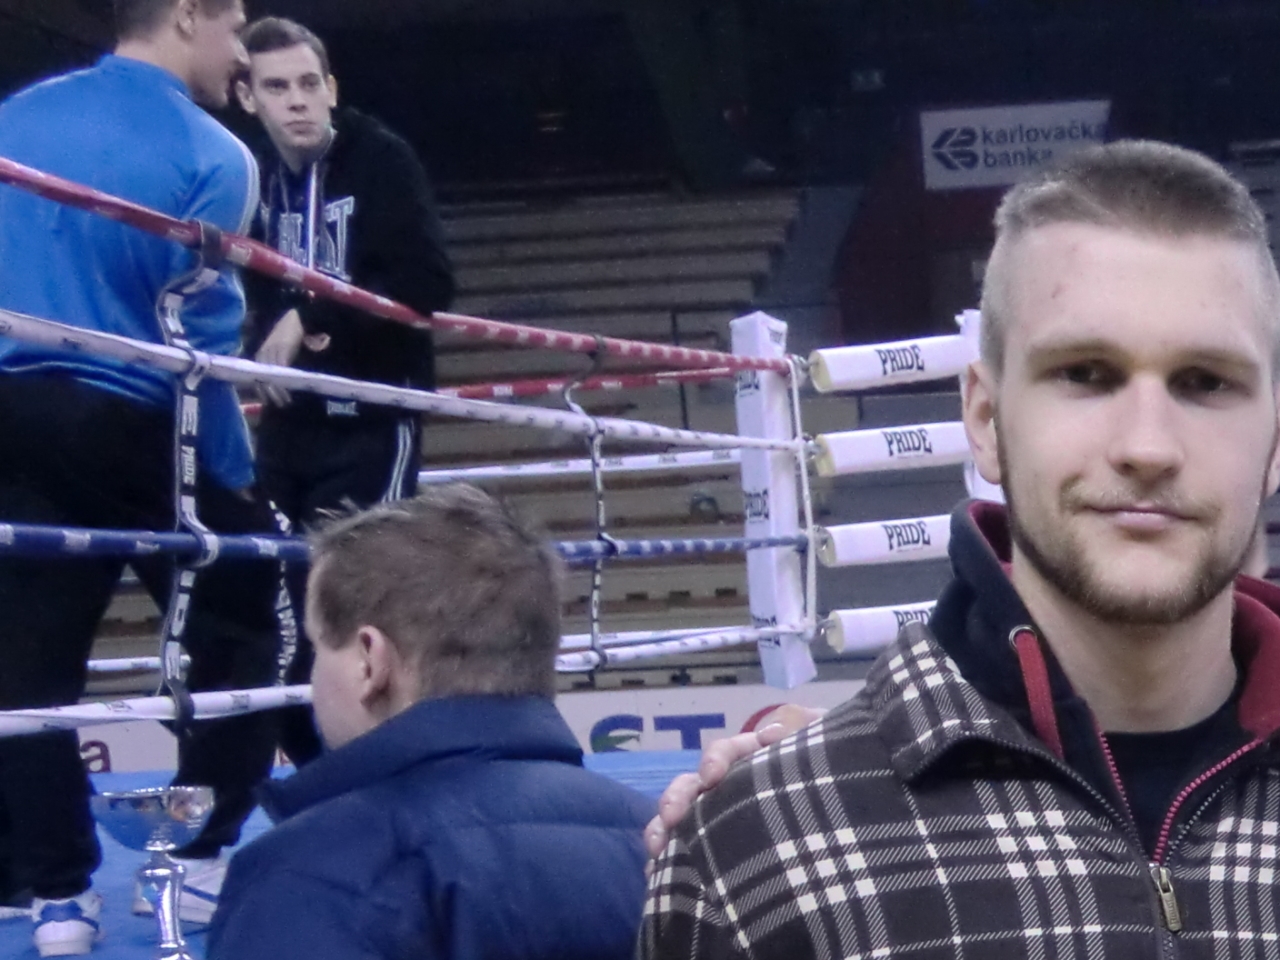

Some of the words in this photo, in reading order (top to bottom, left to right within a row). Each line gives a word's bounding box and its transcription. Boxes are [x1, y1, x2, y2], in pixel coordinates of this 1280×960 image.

[875, 344, 925, 372] PRIDE
[883, 428, 933, 457] PRIDE
[882, 520, 931, 551] PRIDE
[893, 608, 934, 631] PRID
